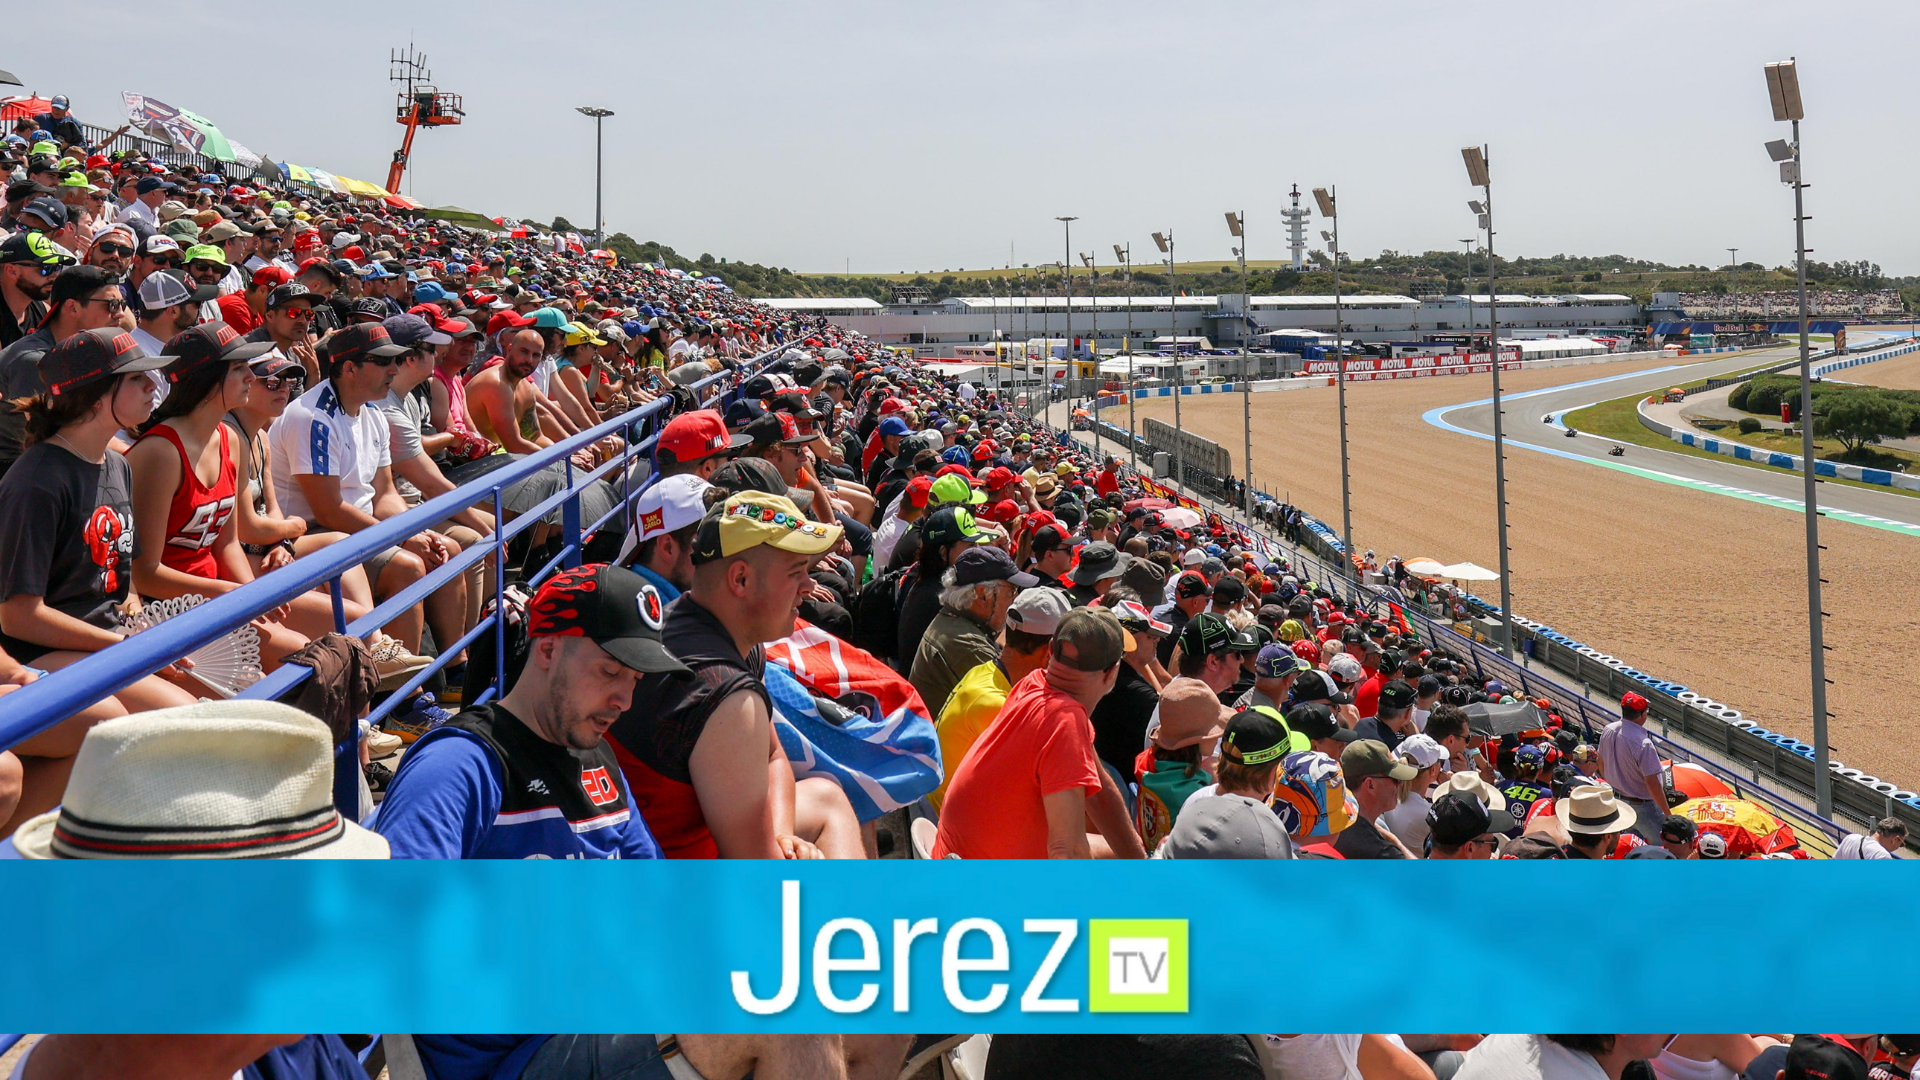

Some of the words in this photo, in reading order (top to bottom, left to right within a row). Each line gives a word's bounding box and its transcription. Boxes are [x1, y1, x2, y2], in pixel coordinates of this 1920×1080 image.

[1308, 361, 1339, 373] MOTUL
[1345, 360, 1375, 371] MOTUL
[1380, 358, 1407, 370] MOTUL
[1411, 357, 1436, 368] MOTUL
[1440, 355, 1465, 366] MOTUL
[1469, 353, 1491, 364] MOTUL
[1353, 373, 1372, 381] MOTUL
[1375, 372, 1394, 380] MOTUL
[1396, 371, 1413, 379] MOTUL
[1415, 369, 1432, 377] MOTUL
[1435, 368, 1452, 376] MOTUL
[1472, 365, 1488, 373] MOTUL
[166, 494, 236, 550] 93
[644, 518, 662, 530] CARLO
[646, 513, 658, 523] SAN
[728, 503, 760, 519] THE
[762, 508, 826, 537] DOCTOR
[581, 765, 619, 807] 20
[1504, 785, 1542, 802] 46
